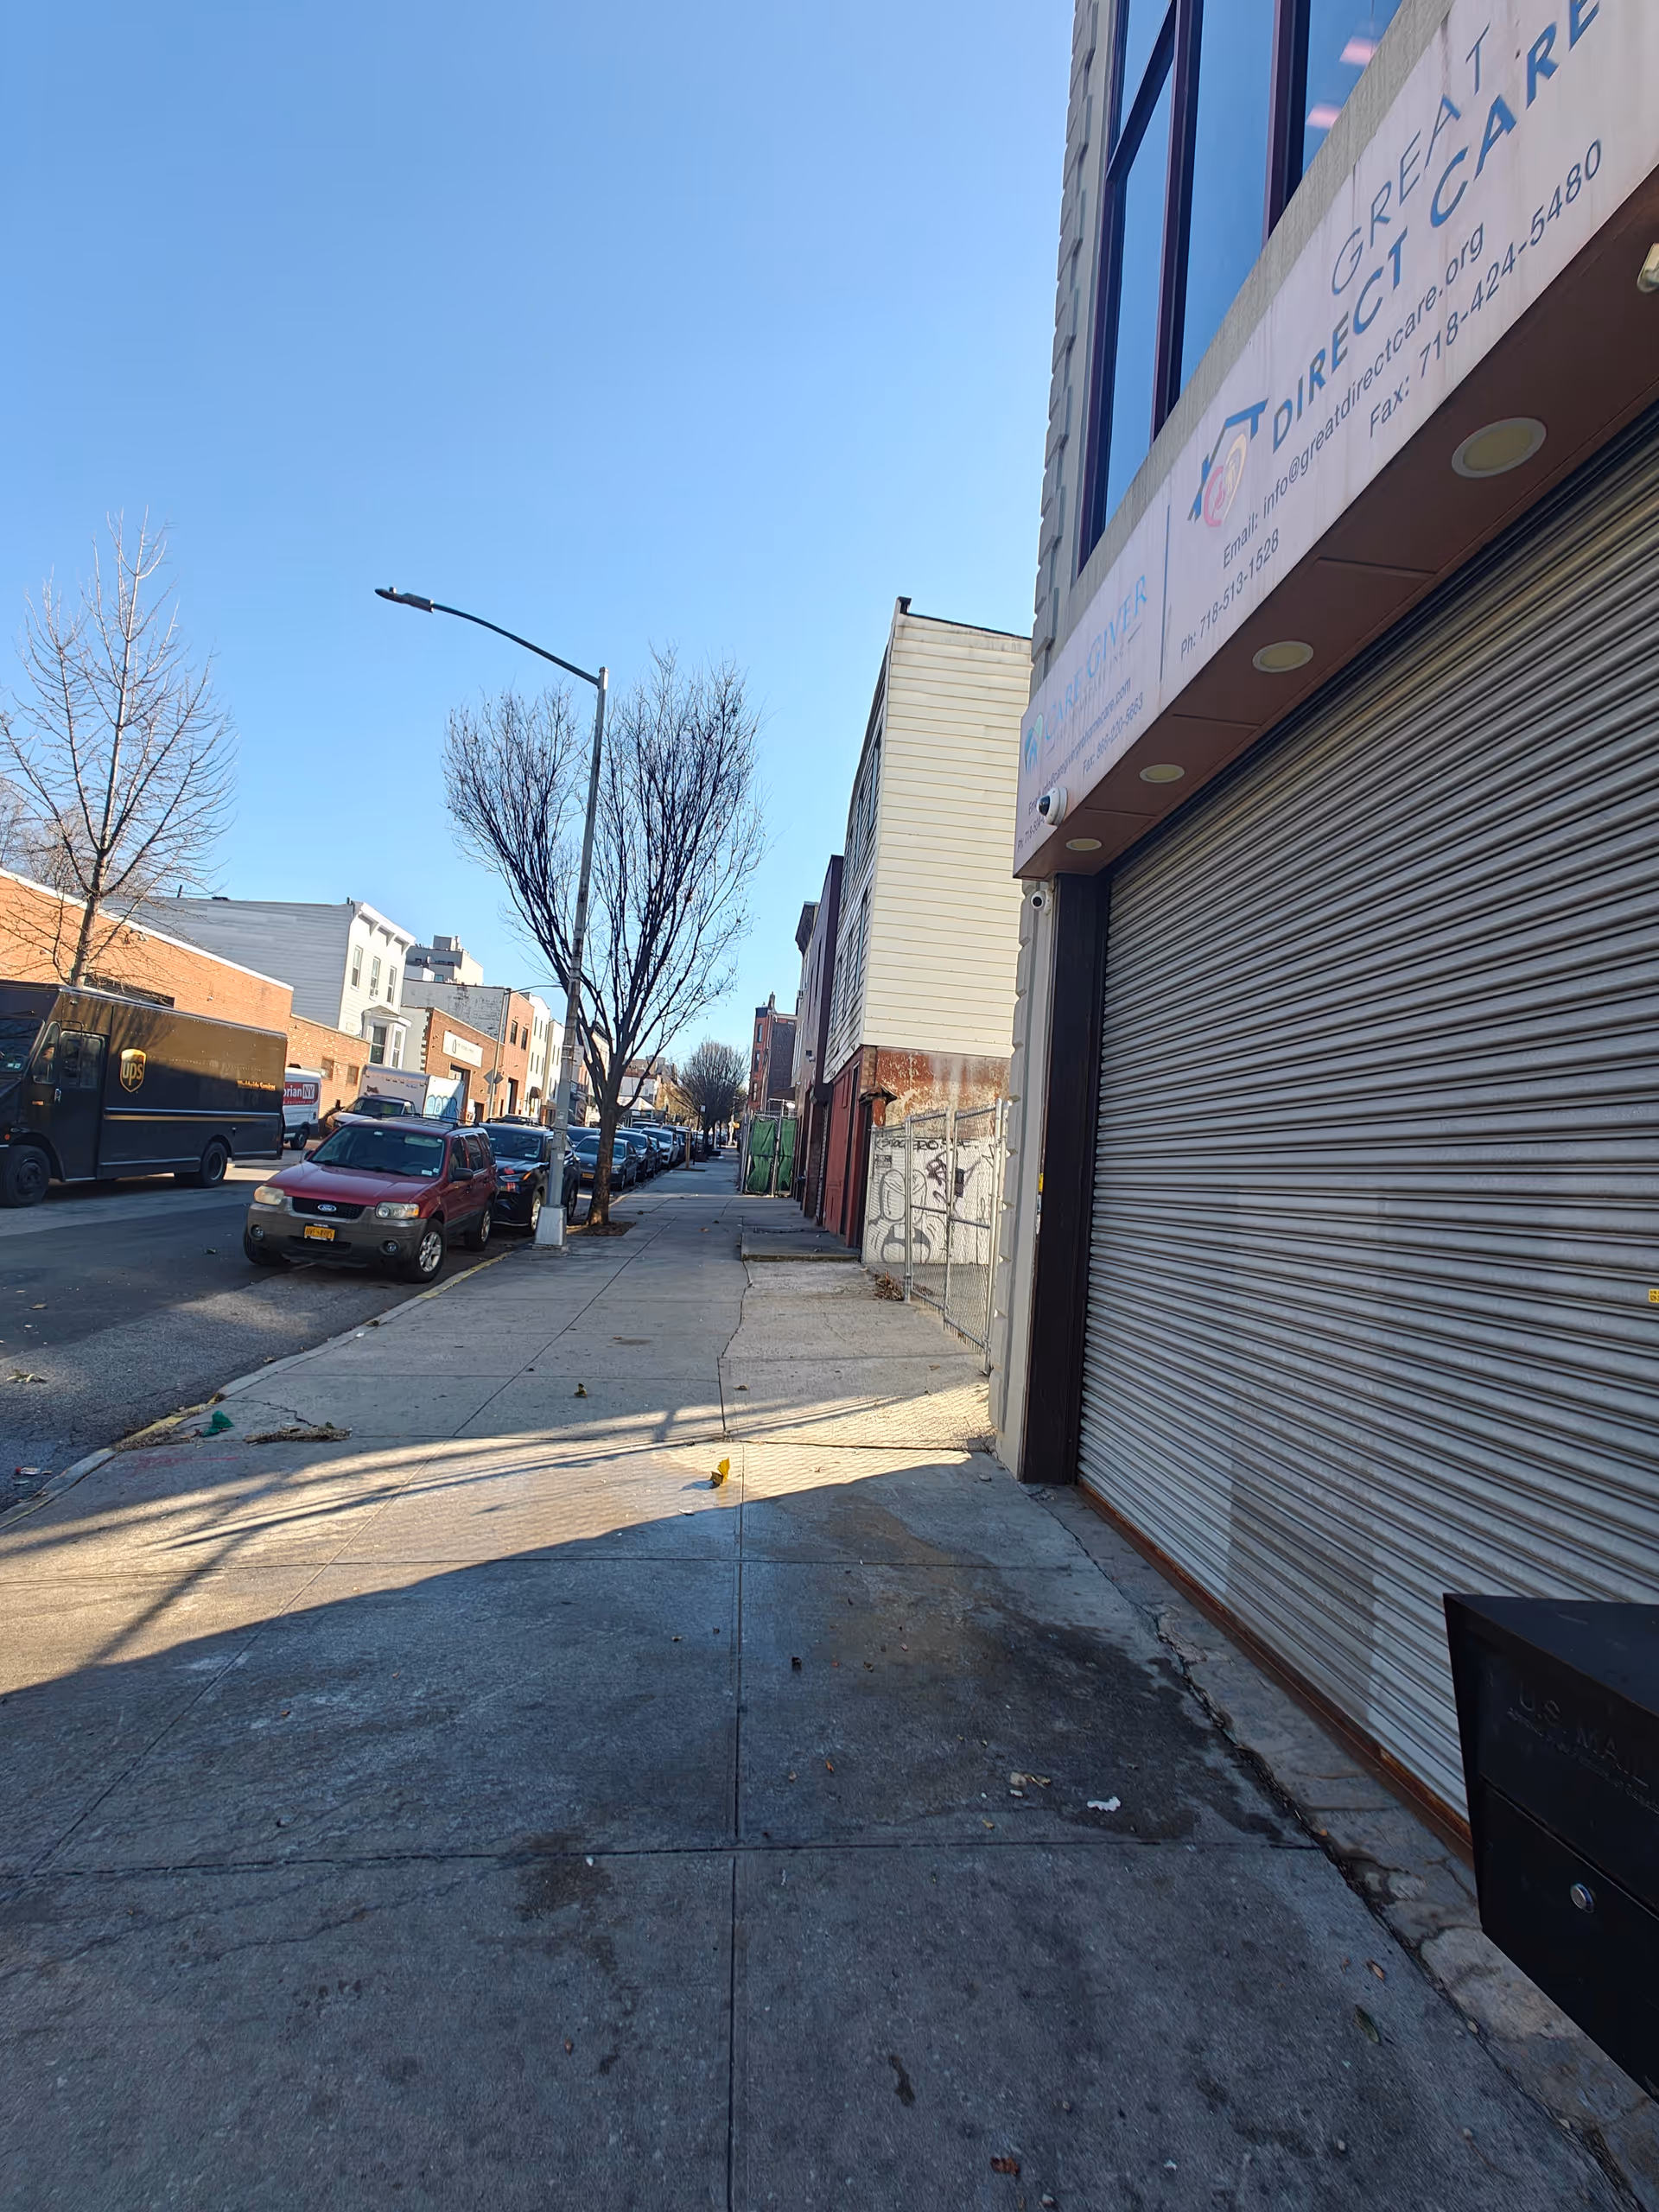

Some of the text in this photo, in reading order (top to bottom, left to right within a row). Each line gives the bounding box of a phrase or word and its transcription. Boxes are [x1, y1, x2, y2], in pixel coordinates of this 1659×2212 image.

[1332, 19, 1491, 295] GREAT
[1180, 138, 1602, 662] Ph: 718-513-1528 Fax: 718-424-5480
[1223, 222, 1484, 569] Email: info@greatdirectcare.org
[1273, 226, 1408, 454] DIRECT
[1046, 575, 1148, 741] CARE GIVER
[122, 1061, 143, 1086] ups
